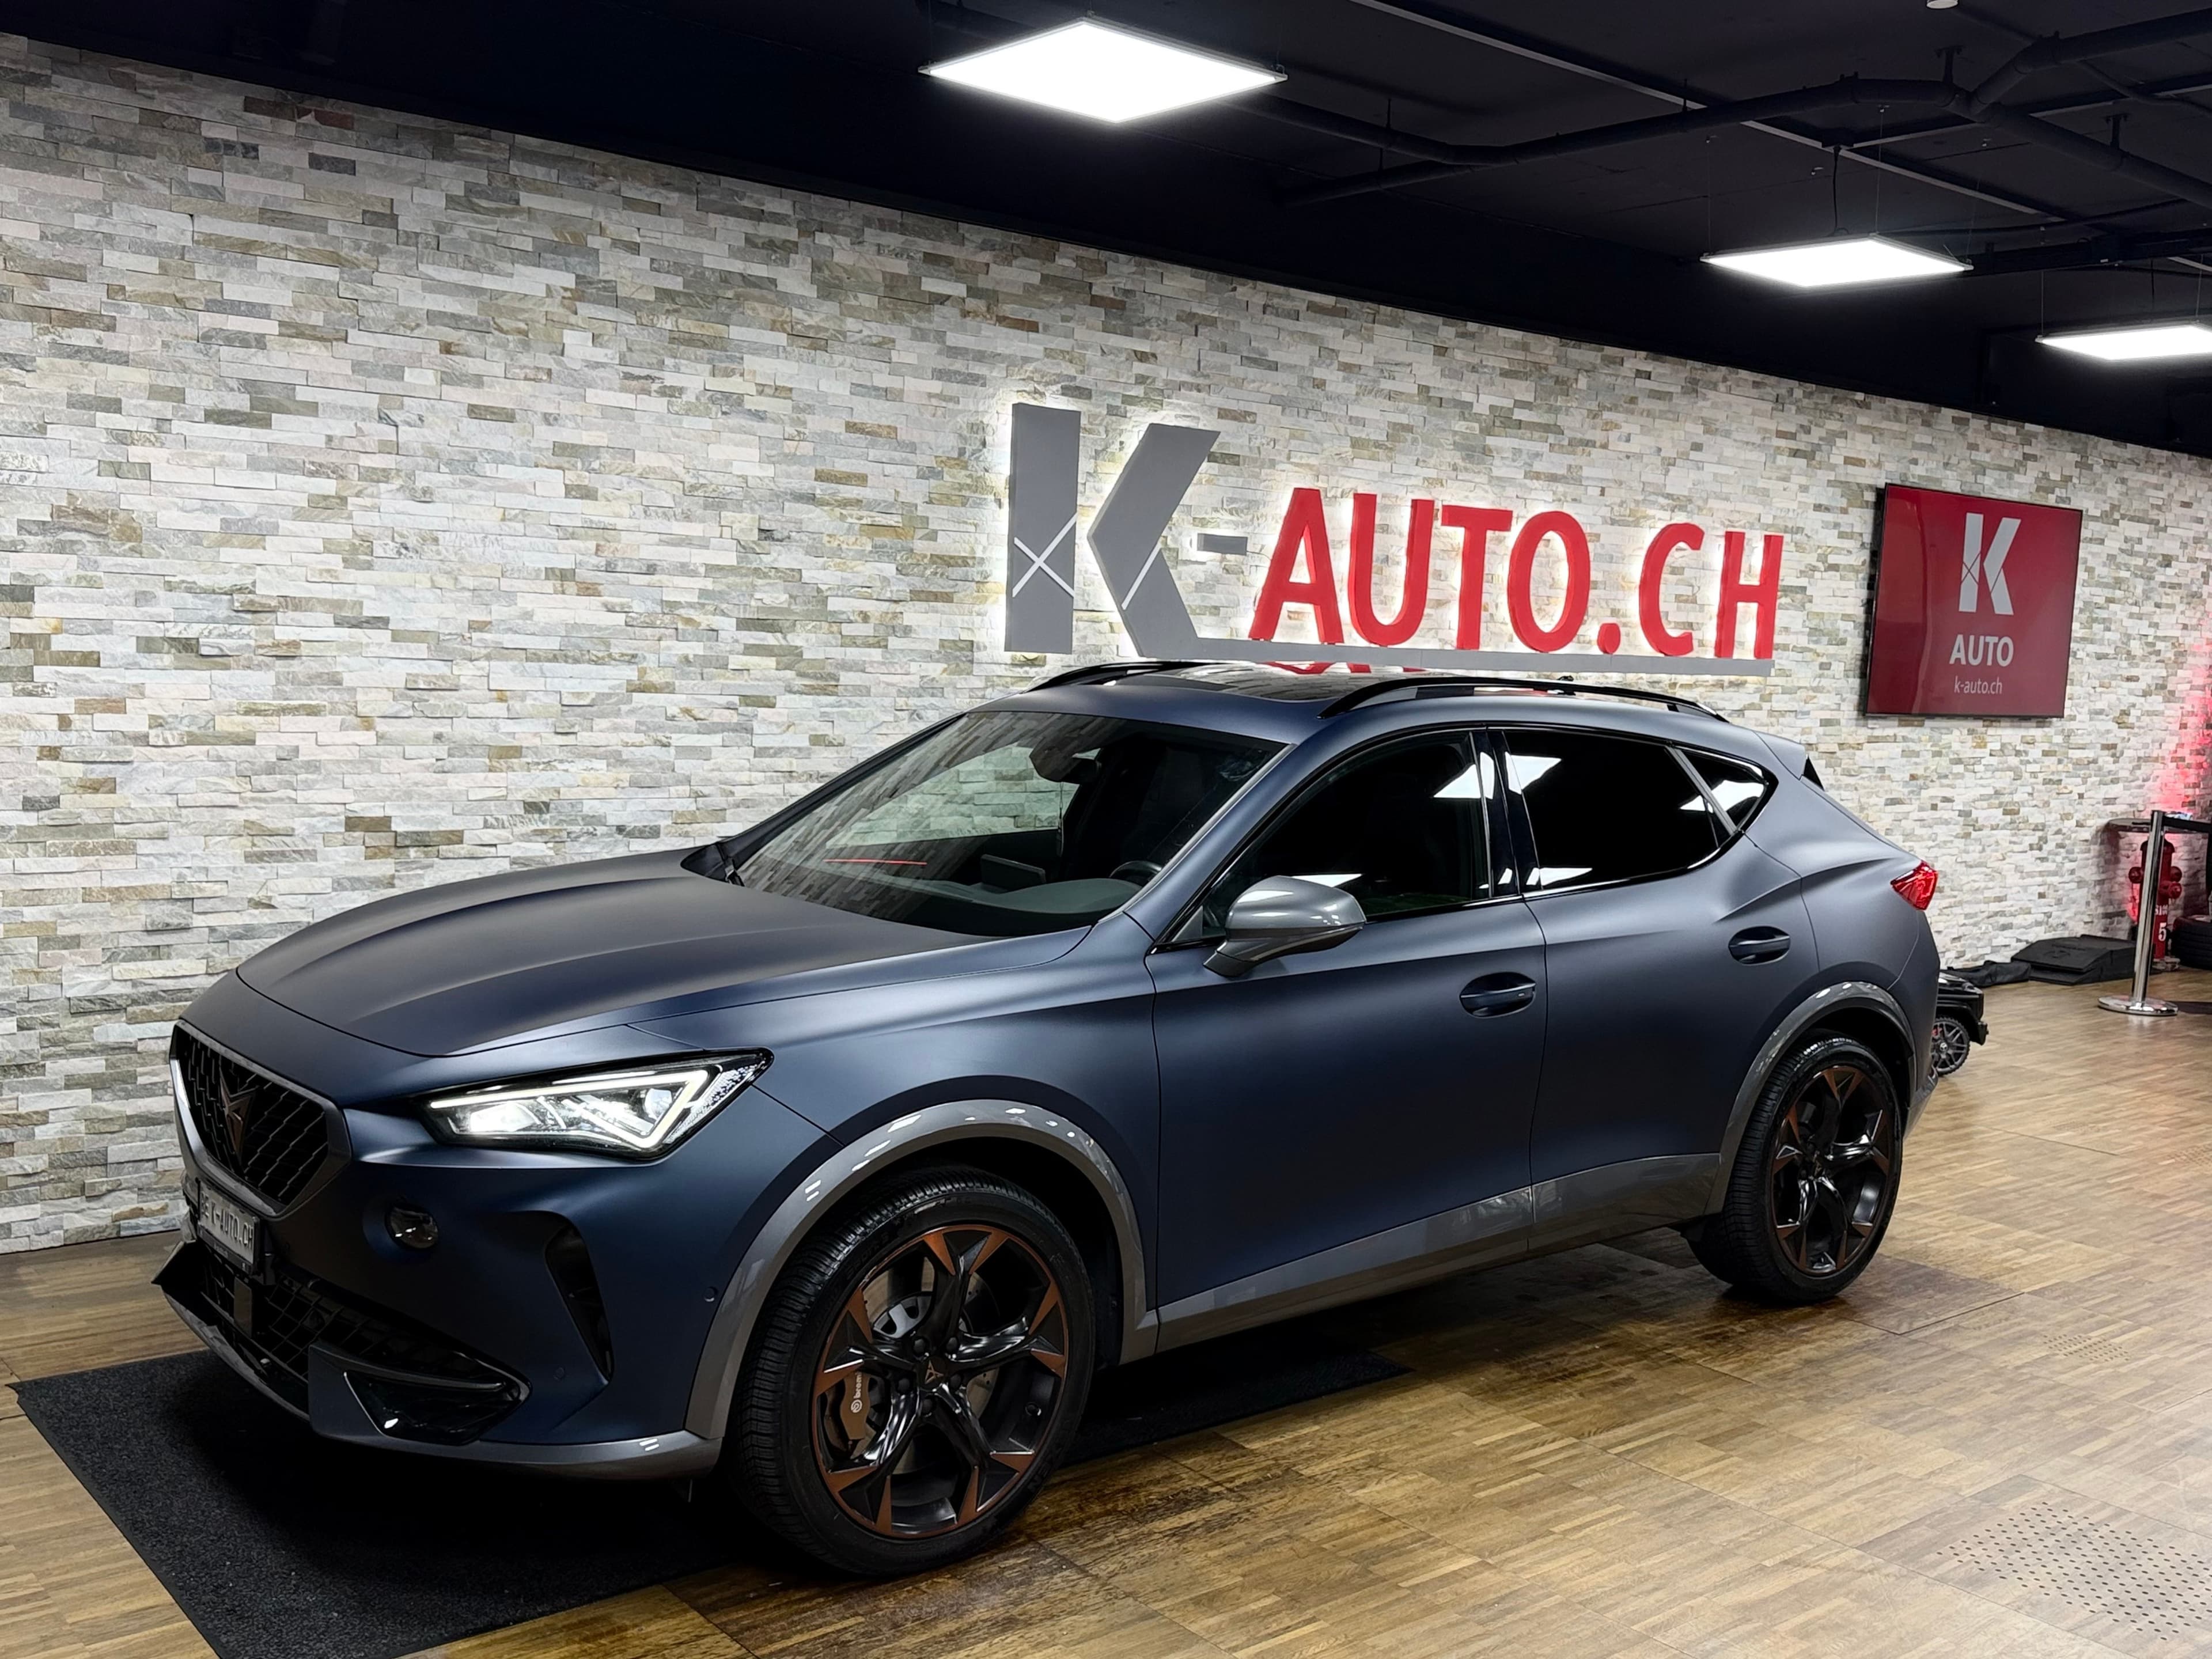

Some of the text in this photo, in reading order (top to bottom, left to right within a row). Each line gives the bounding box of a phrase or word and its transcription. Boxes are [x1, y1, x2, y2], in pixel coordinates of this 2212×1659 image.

[1004, 403, 1782, 661] K-AUTO.CH
[1959, 512, 2021, 615] K
[1949, 634, 2014, 666] AUTO
[1954, 676, 2003, 694] k-auto.ch
